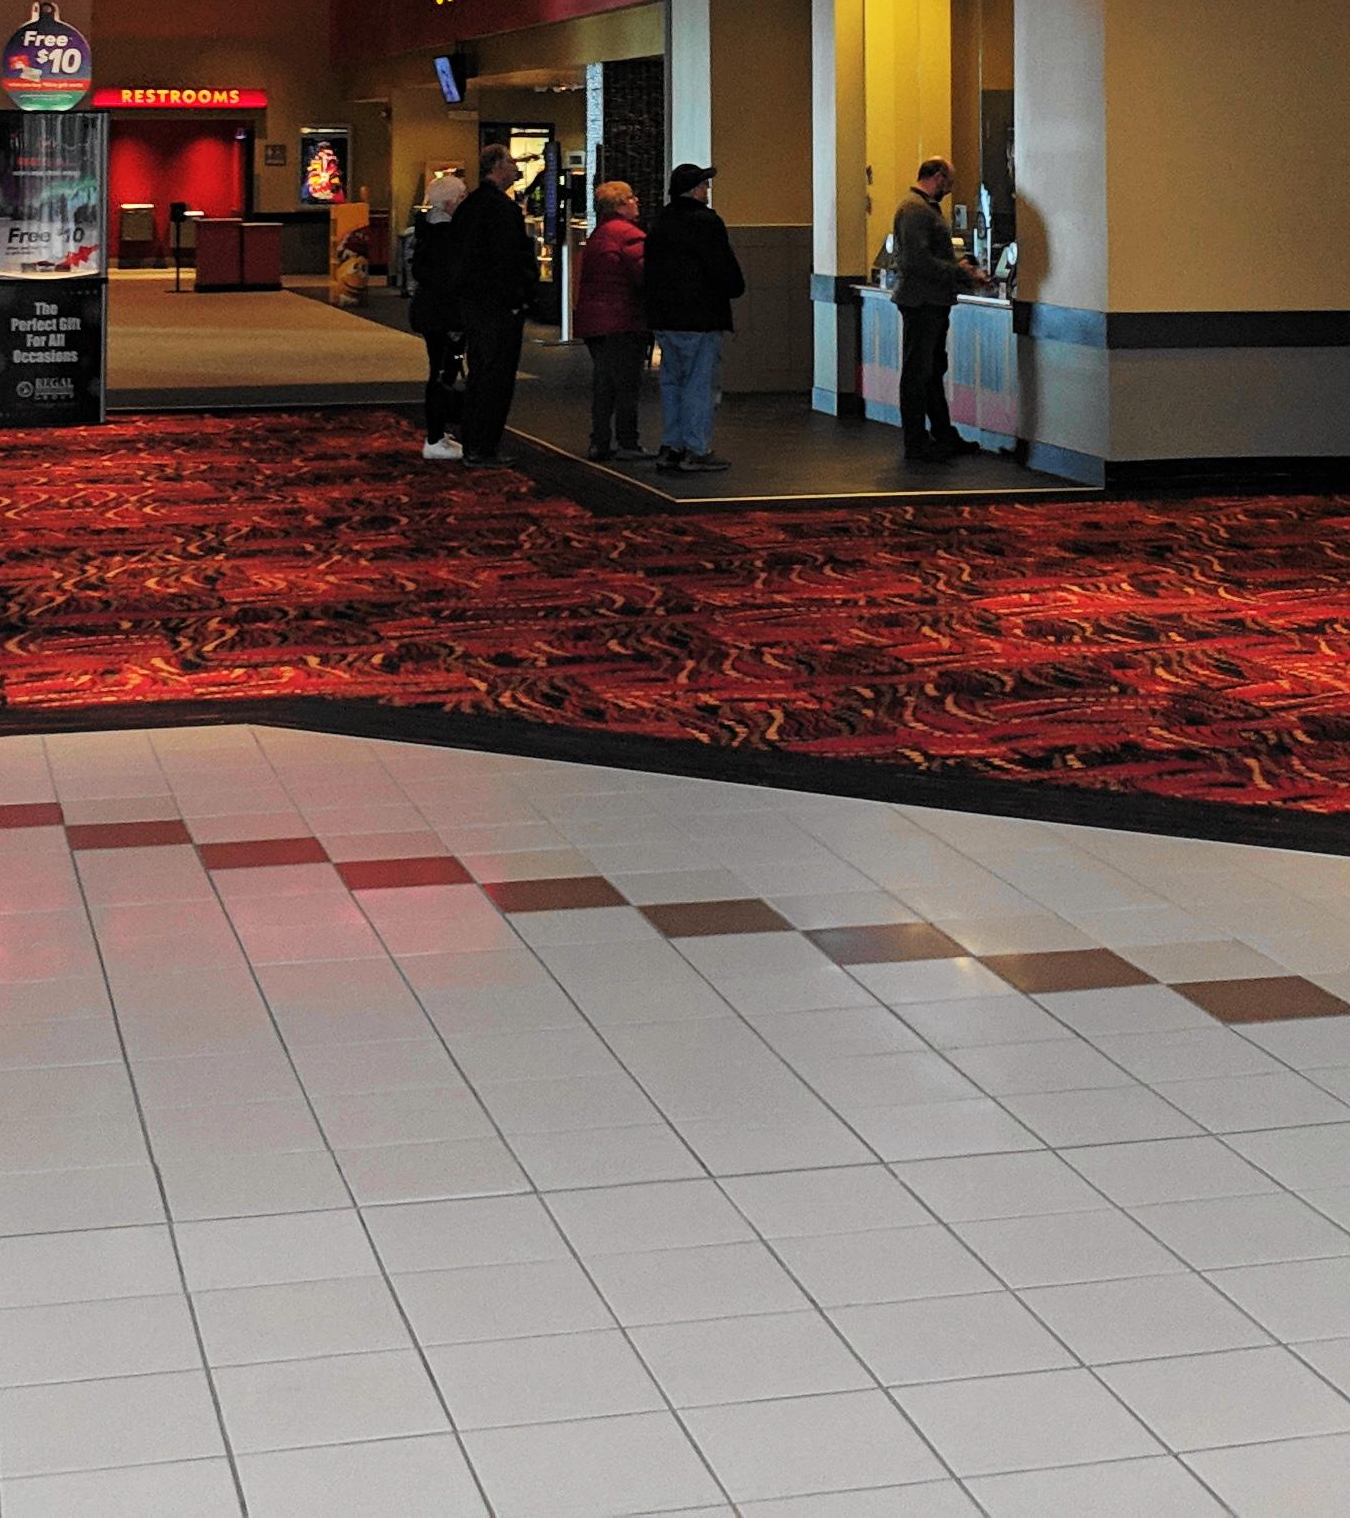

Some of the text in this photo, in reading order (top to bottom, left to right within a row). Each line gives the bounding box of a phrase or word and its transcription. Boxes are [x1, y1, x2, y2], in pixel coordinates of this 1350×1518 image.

[23, 30, 69, 47] Free
[35, 48, 82, 74] $10
[121, 89, 240, 104] RESTROOMS
[7, 227, 51, 243] Free
[34, 302, 58, 315] The
[11, 318, 57, 331] Perfect
[26, 334, 65, 347] For All
[13, 350, 79, 363] Occasions
